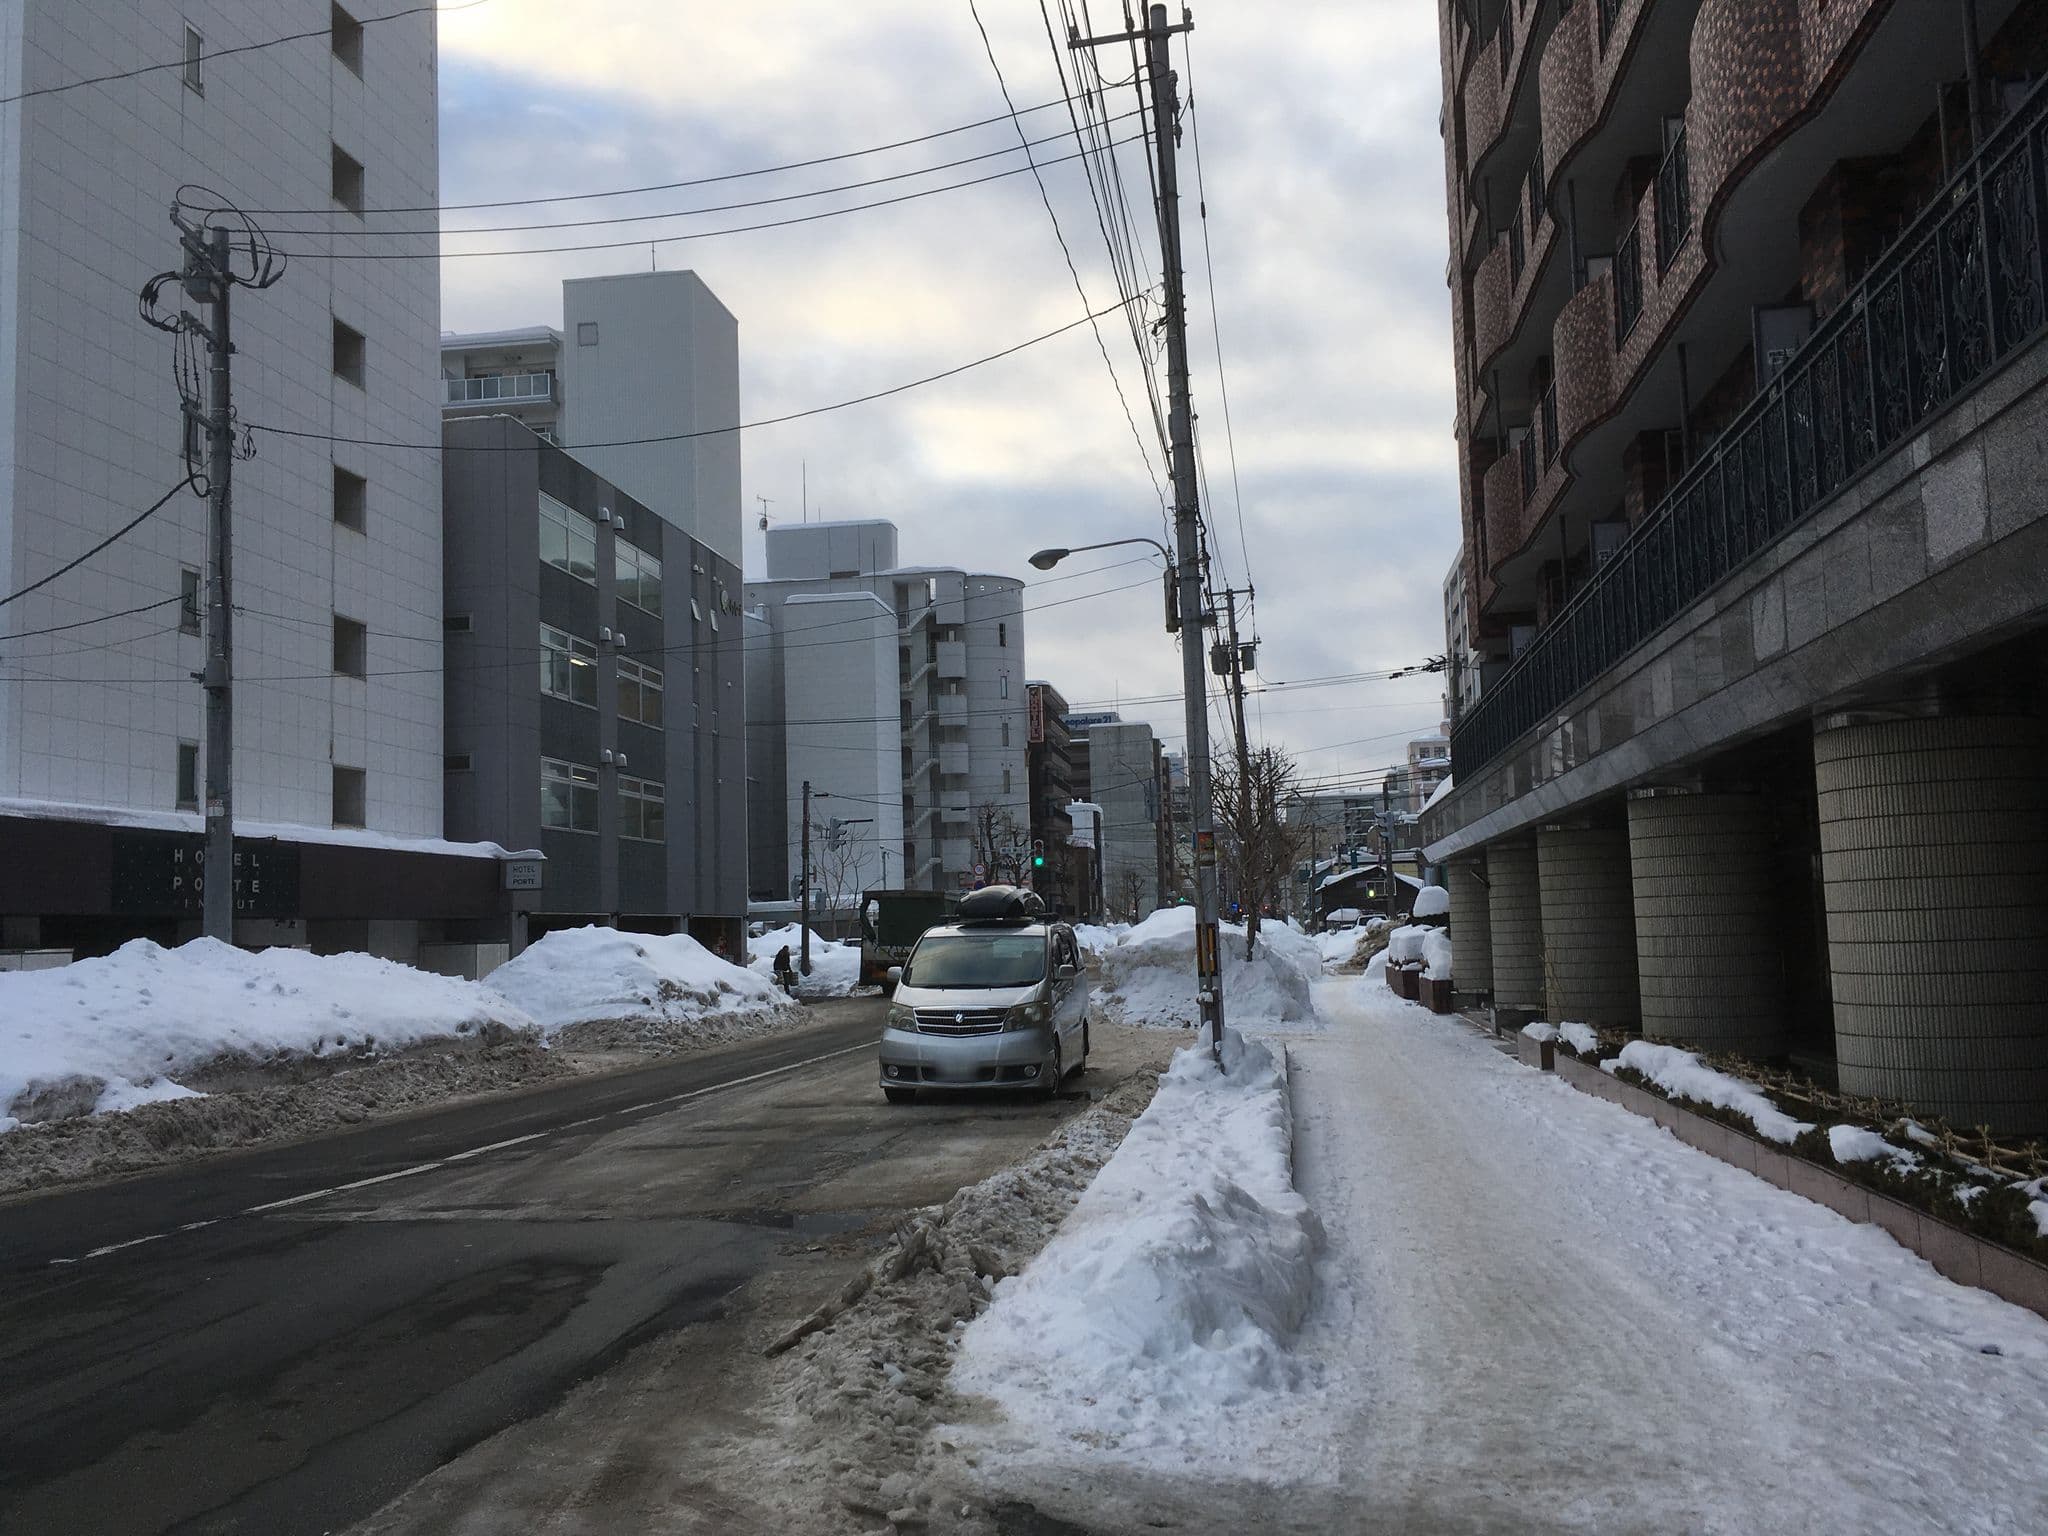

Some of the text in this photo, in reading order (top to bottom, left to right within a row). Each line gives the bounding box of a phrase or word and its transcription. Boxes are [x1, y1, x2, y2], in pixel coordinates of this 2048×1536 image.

[174, 849, 259, 867] HOEL
[513, 865, 536, 873] HOTEL
[173, 876, 260, 893] POTE
